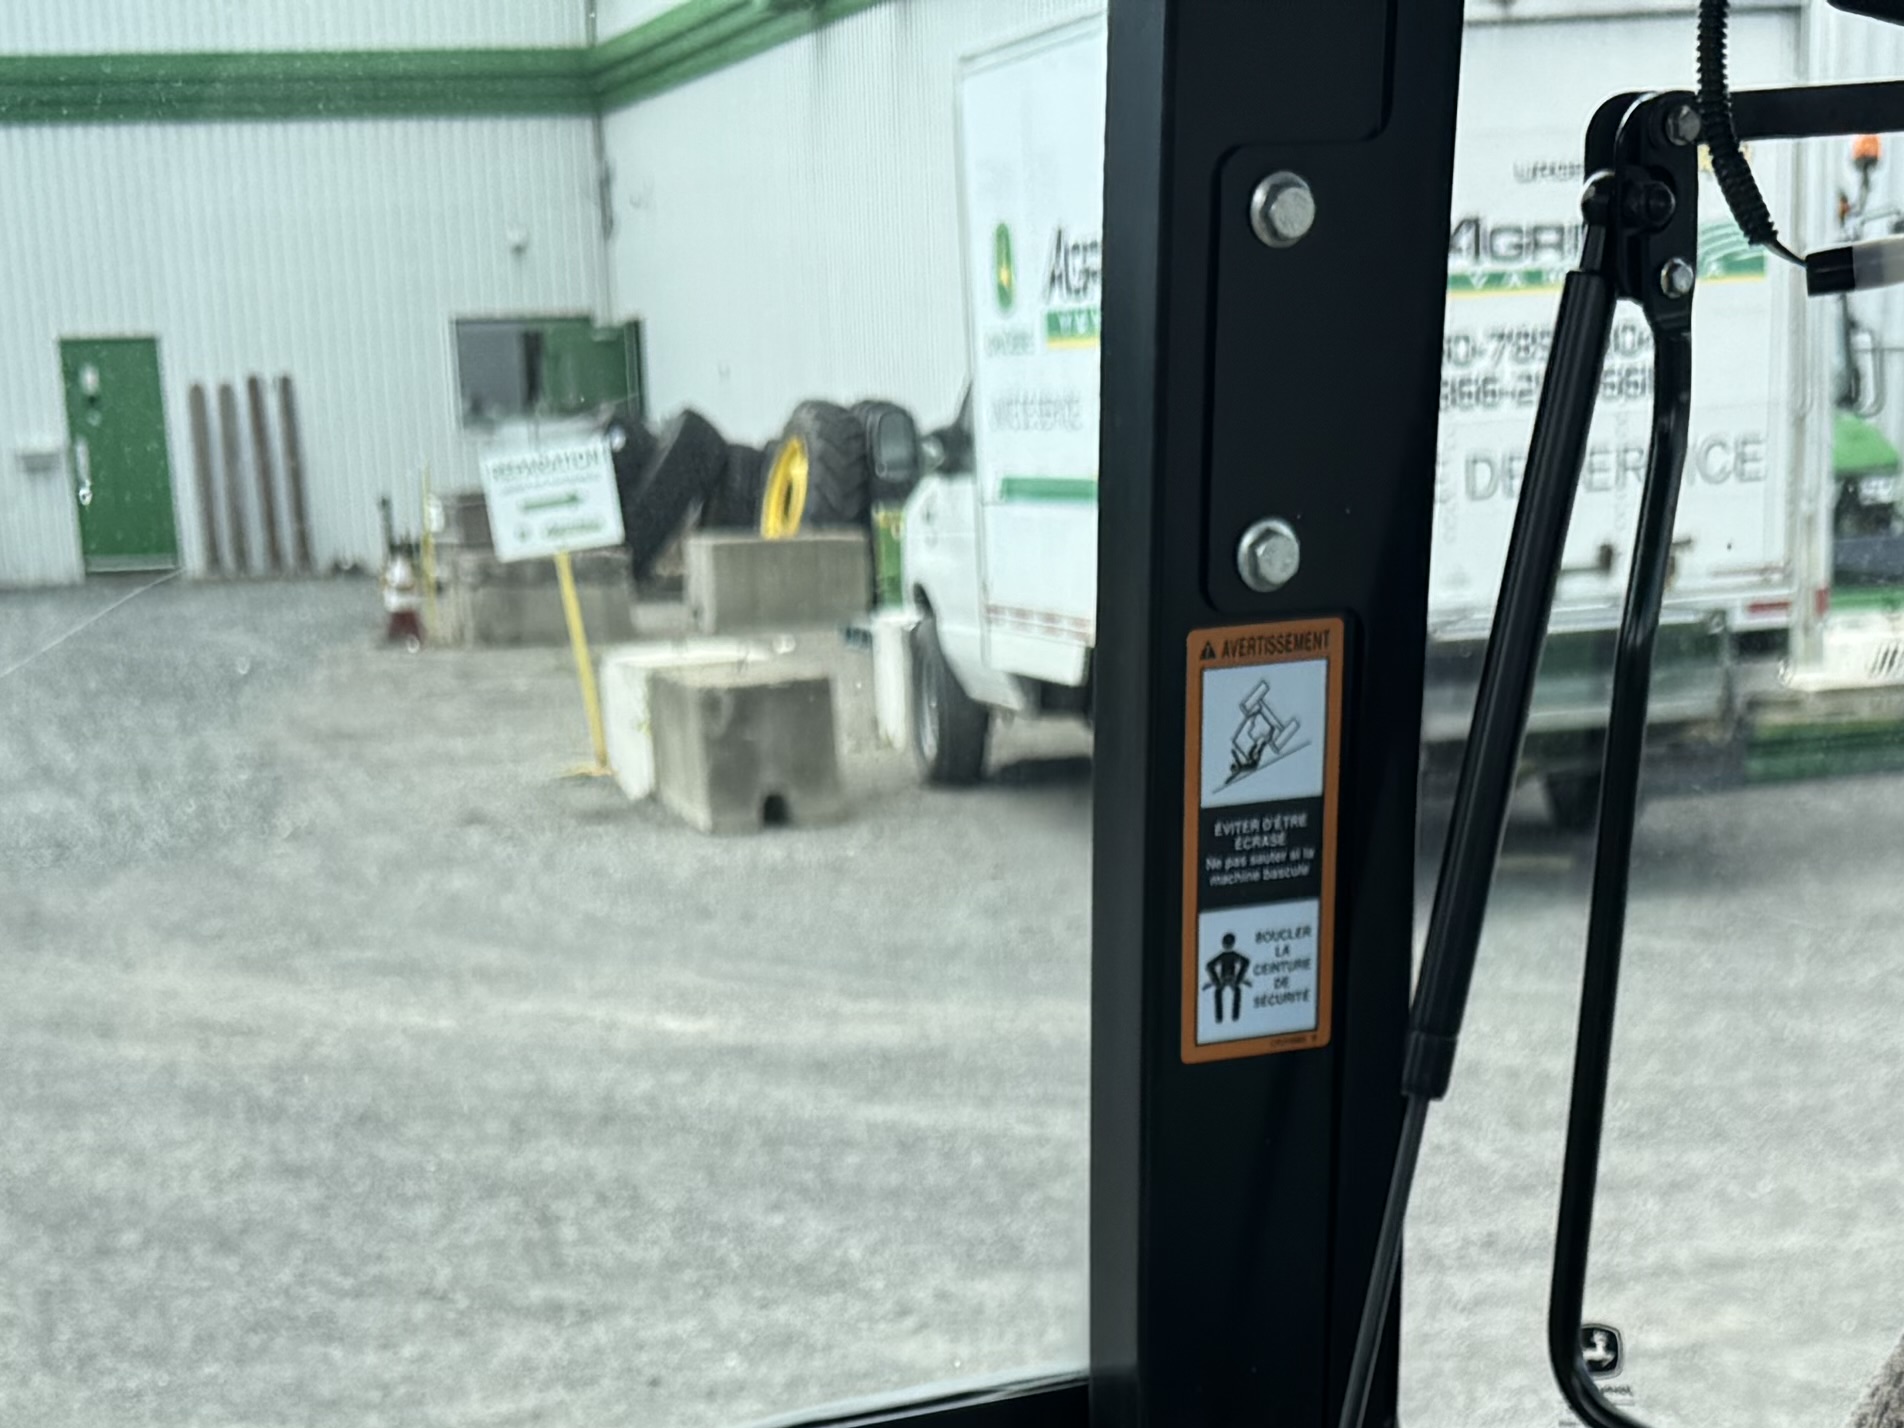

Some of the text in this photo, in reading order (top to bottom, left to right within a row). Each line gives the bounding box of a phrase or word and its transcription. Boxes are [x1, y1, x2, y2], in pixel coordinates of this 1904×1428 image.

[1222, 629, 1330, 659] AVERTISSEMENT
[1214, 818, 1259, 837] ÉVITER
[1234, 831, 1287, 851] ÉCRASÉ
[1205, 847, 1315, 873] Ne pas sauter si la
[1209, 864, 1310, 887] machine bascule
[1254, 925, 1312, 944] BOUCLER
[1275, 944, 1290, 958] LA
[1252, 958, 1311, 977] CEINTURE
[1273, 977, 1290, 991] DE
[1253, 988, 1310, 1009] SÉCURITÉ
